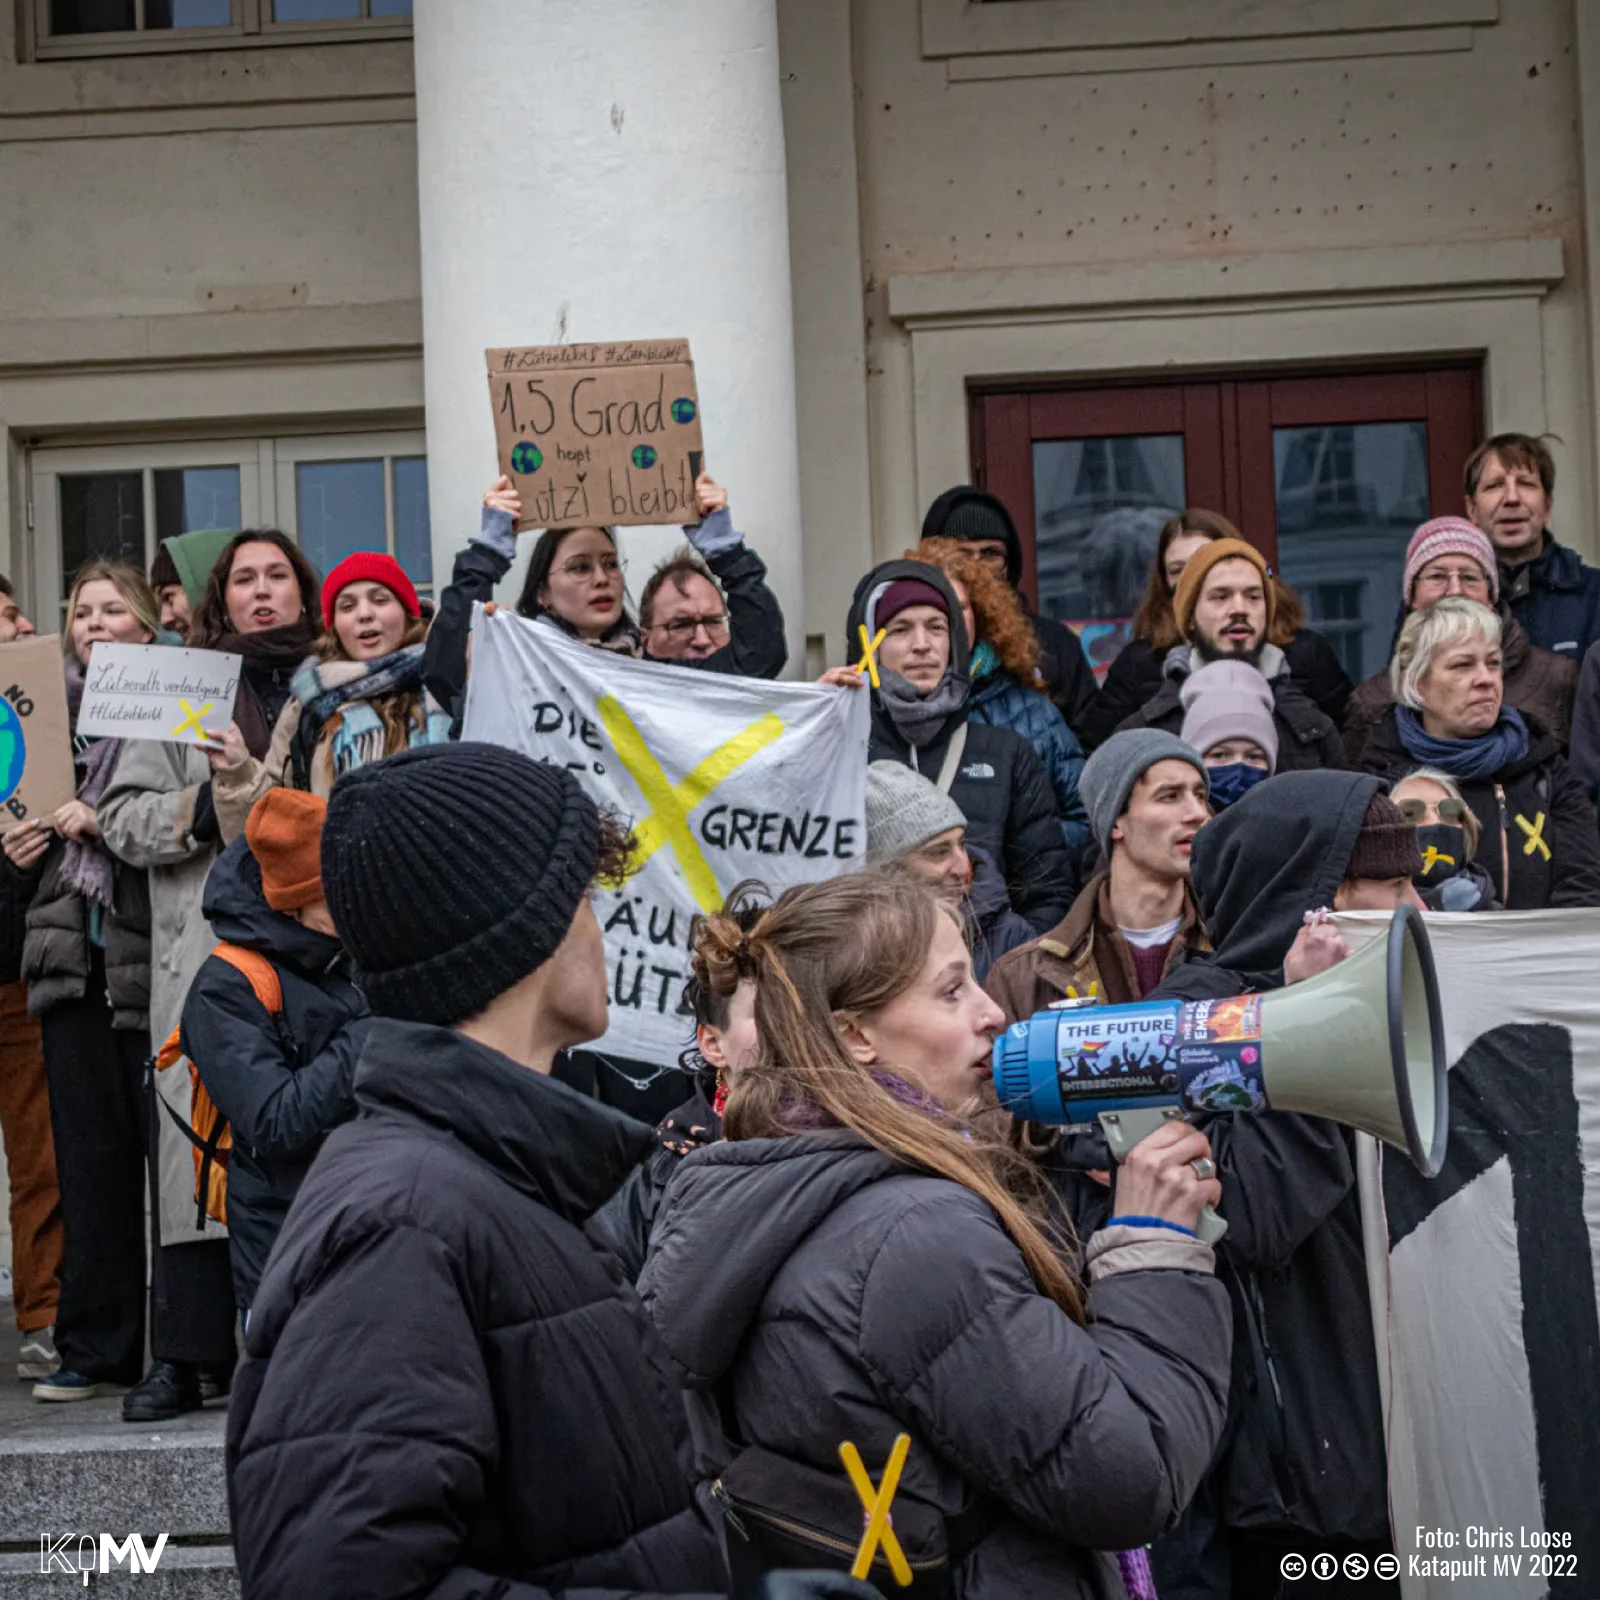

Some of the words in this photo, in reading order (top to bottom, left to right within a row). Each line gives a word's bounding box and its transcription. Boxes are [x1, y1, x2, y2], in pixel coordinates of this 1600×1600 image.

[500, 378, 556, 436] 1,5
[571, 372, 666, 437] Grad
[88, 663, 161, 693] Lützerath
[4, 684, 35, 717] NO
[533, 701, 603, 752] DIE
[700, 804, 858, 860] GRENZE
[1067, 1024, 1102, 1038] THE
[1107, 1019, 1174, 1036] FUTURE
[1062, 1075, 1156, 1092] INTERSECTIONAL
